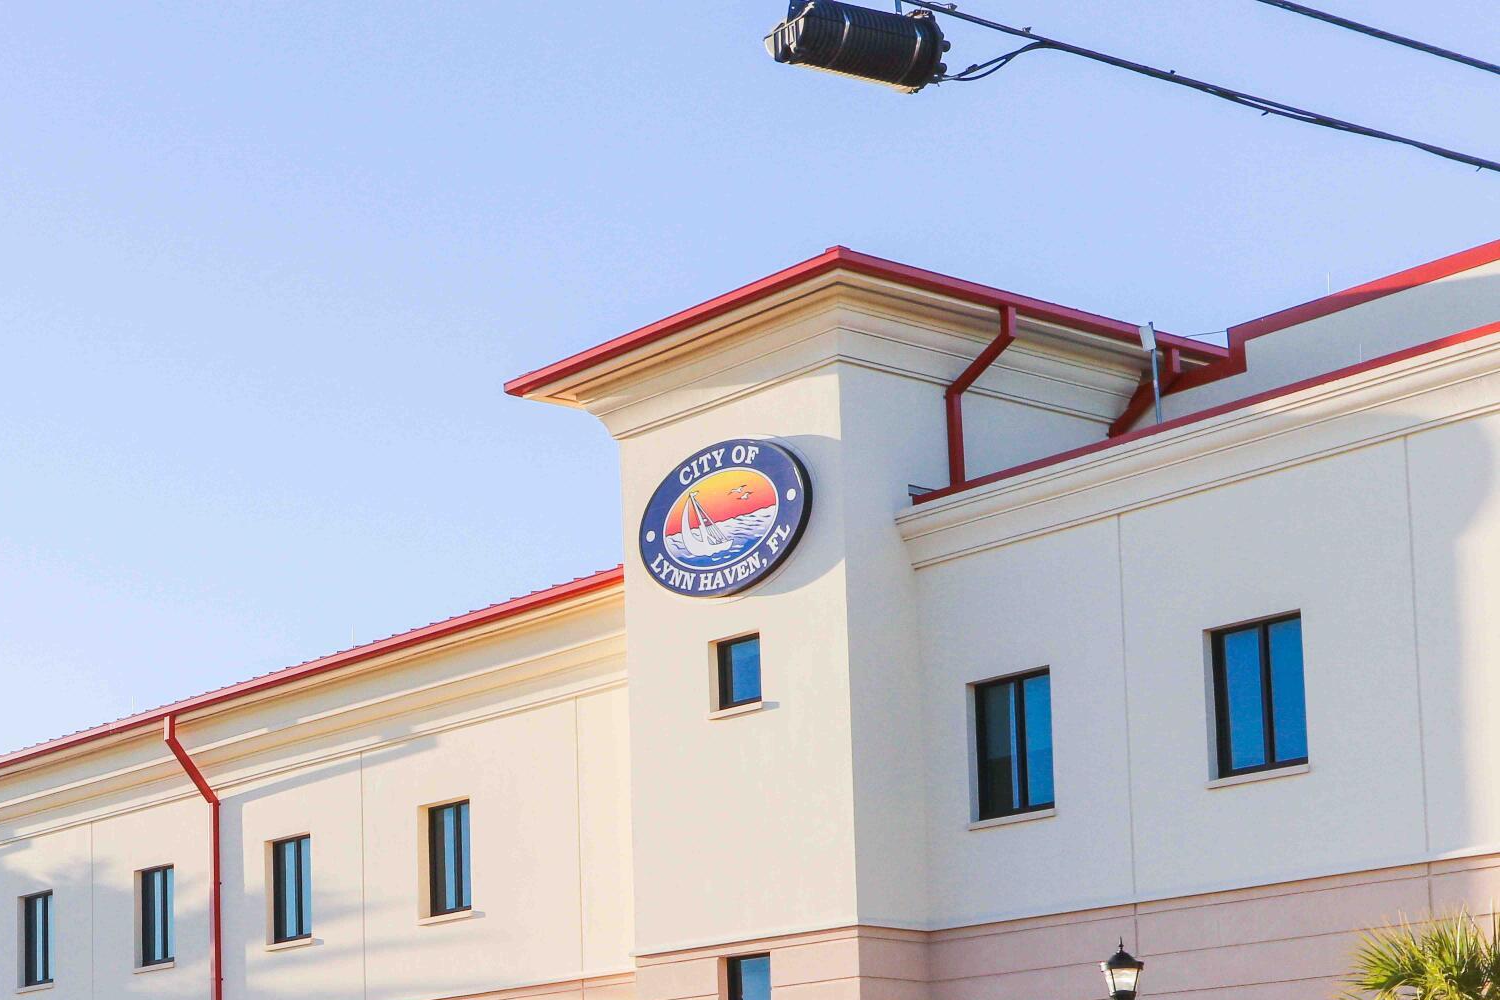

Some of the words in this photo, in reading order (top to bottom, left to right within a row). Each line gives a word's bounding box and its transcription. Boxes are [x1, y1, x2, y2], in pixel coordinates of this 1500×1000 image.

[679, 447, 725, 485] CITY
[731, 445, 759, 465] OF
[650, 553, 697, 591] LYNN
[698, 551, 768, 591] HAVEN,
[765, 522, 791, 554] FL
